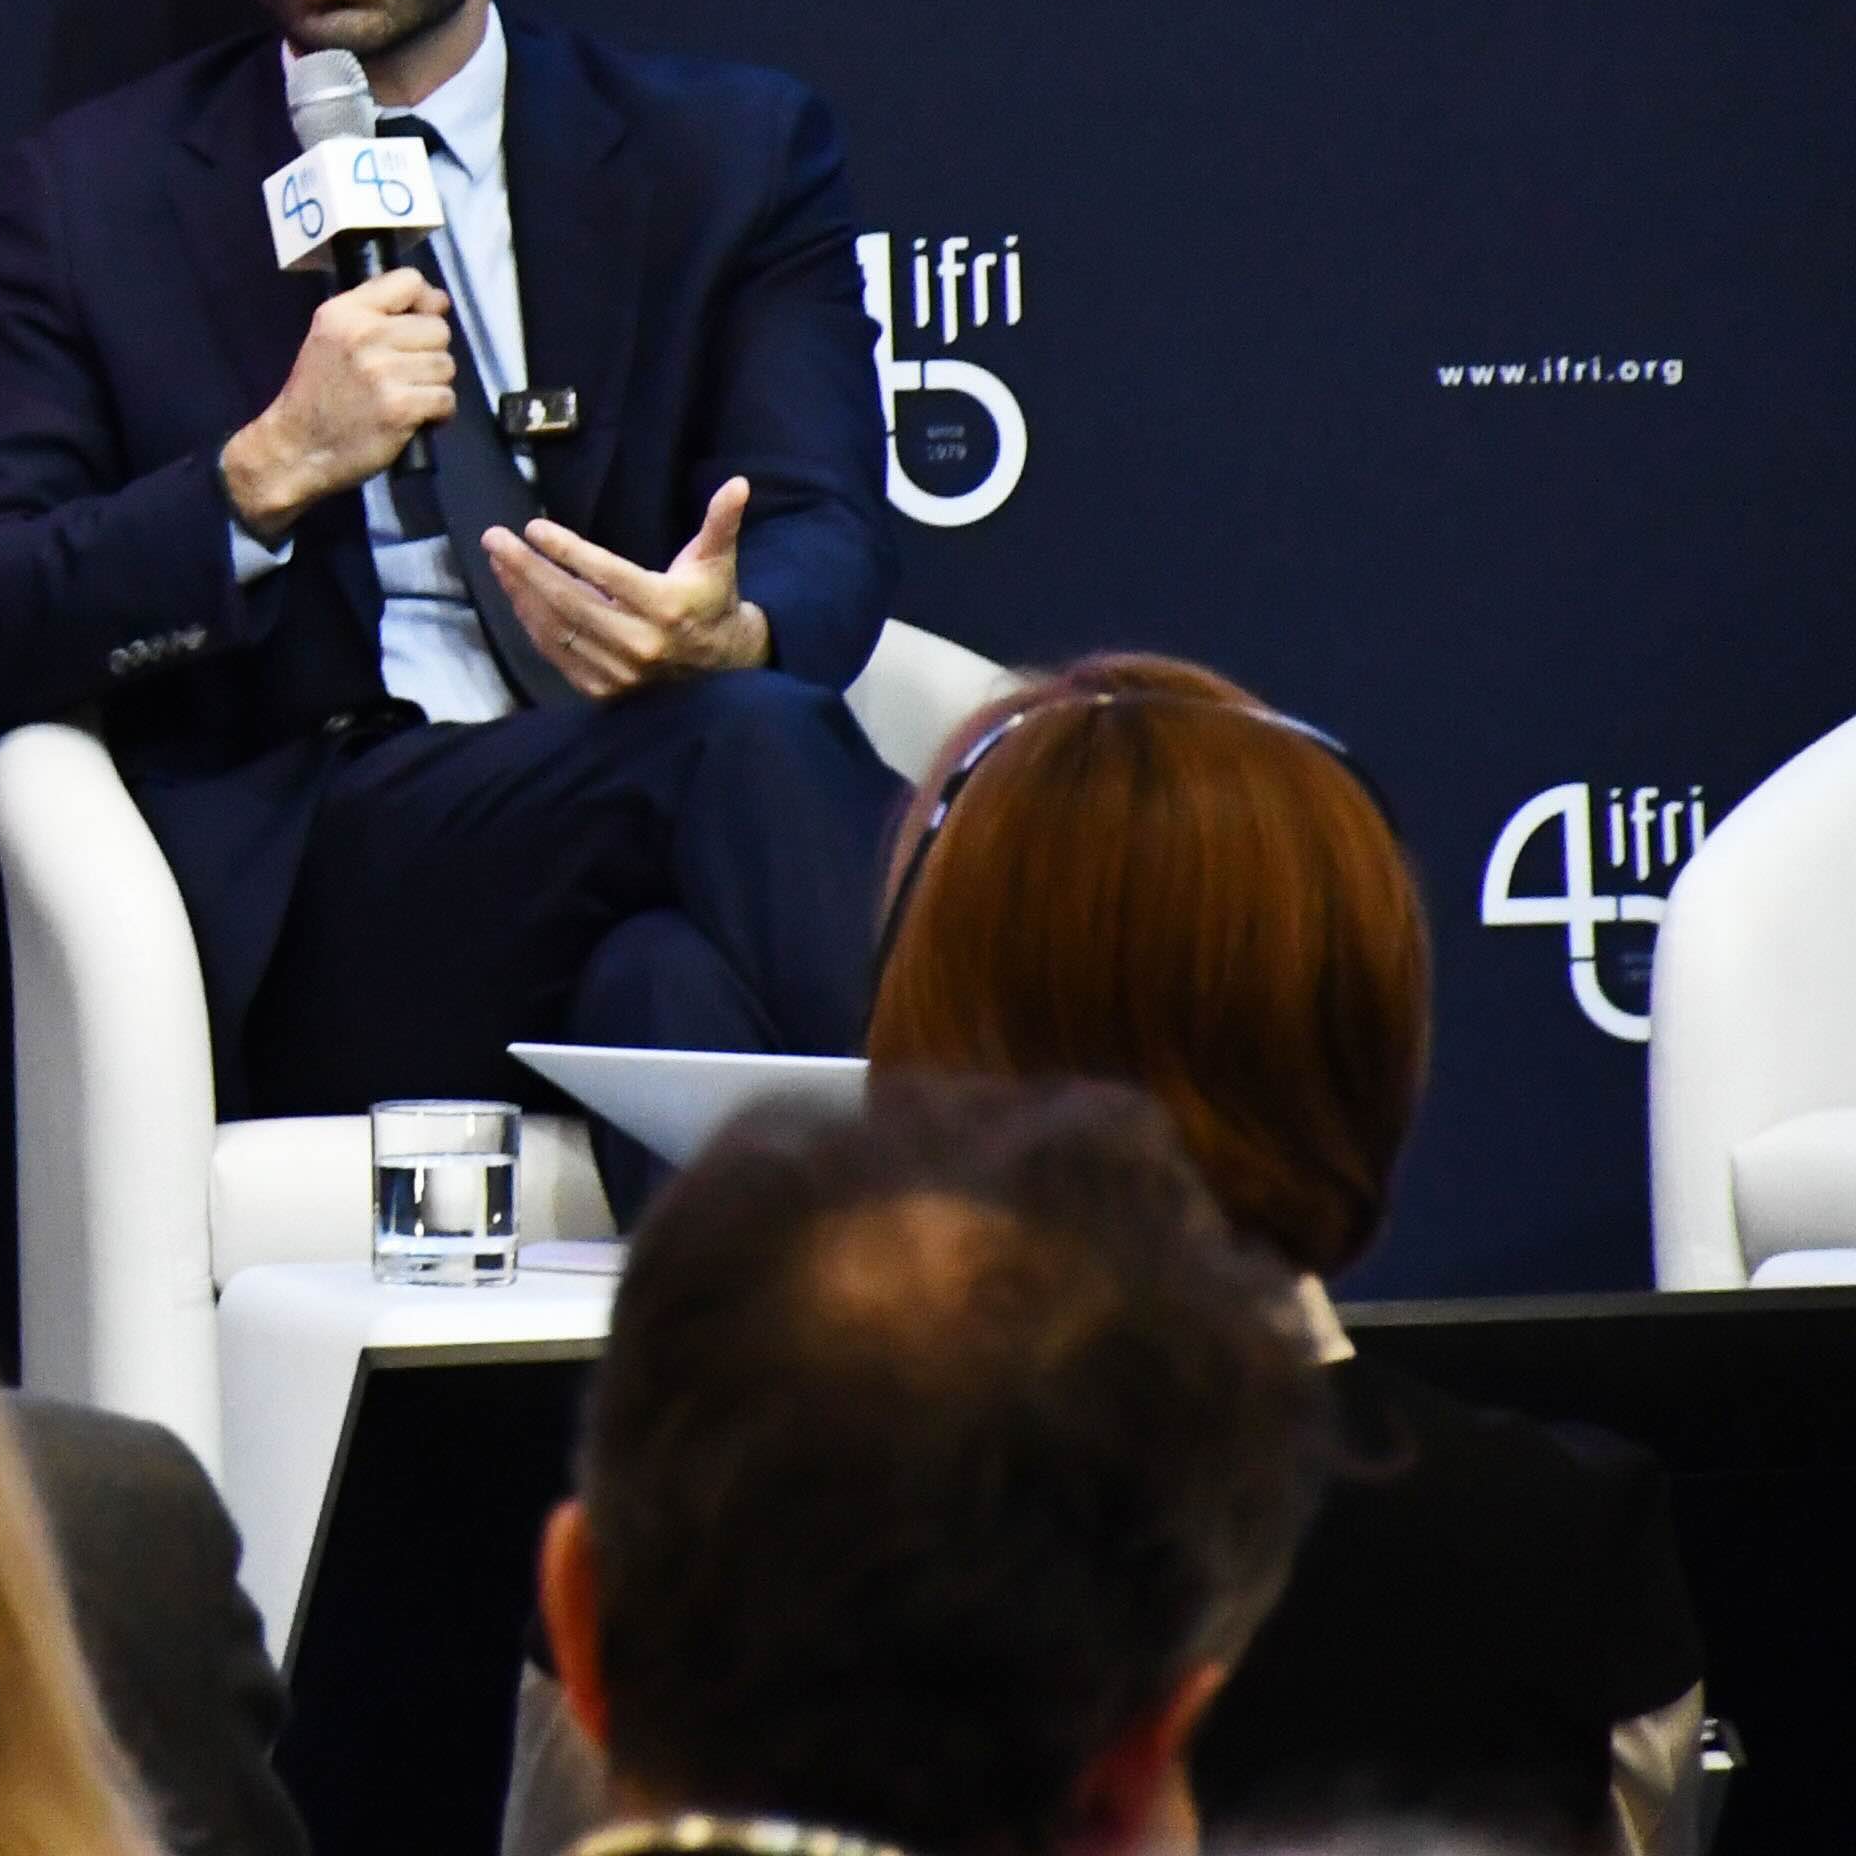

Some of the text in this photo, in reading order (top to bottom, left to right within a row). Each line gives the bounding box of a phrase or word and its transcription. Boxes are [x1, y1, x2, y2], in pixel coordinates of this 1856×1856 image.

[912, 234, 1023, 345] ifri
[1437, 354, 1685, 387] www.ifri.org
[1607, 784, 1706, 882] ifri
